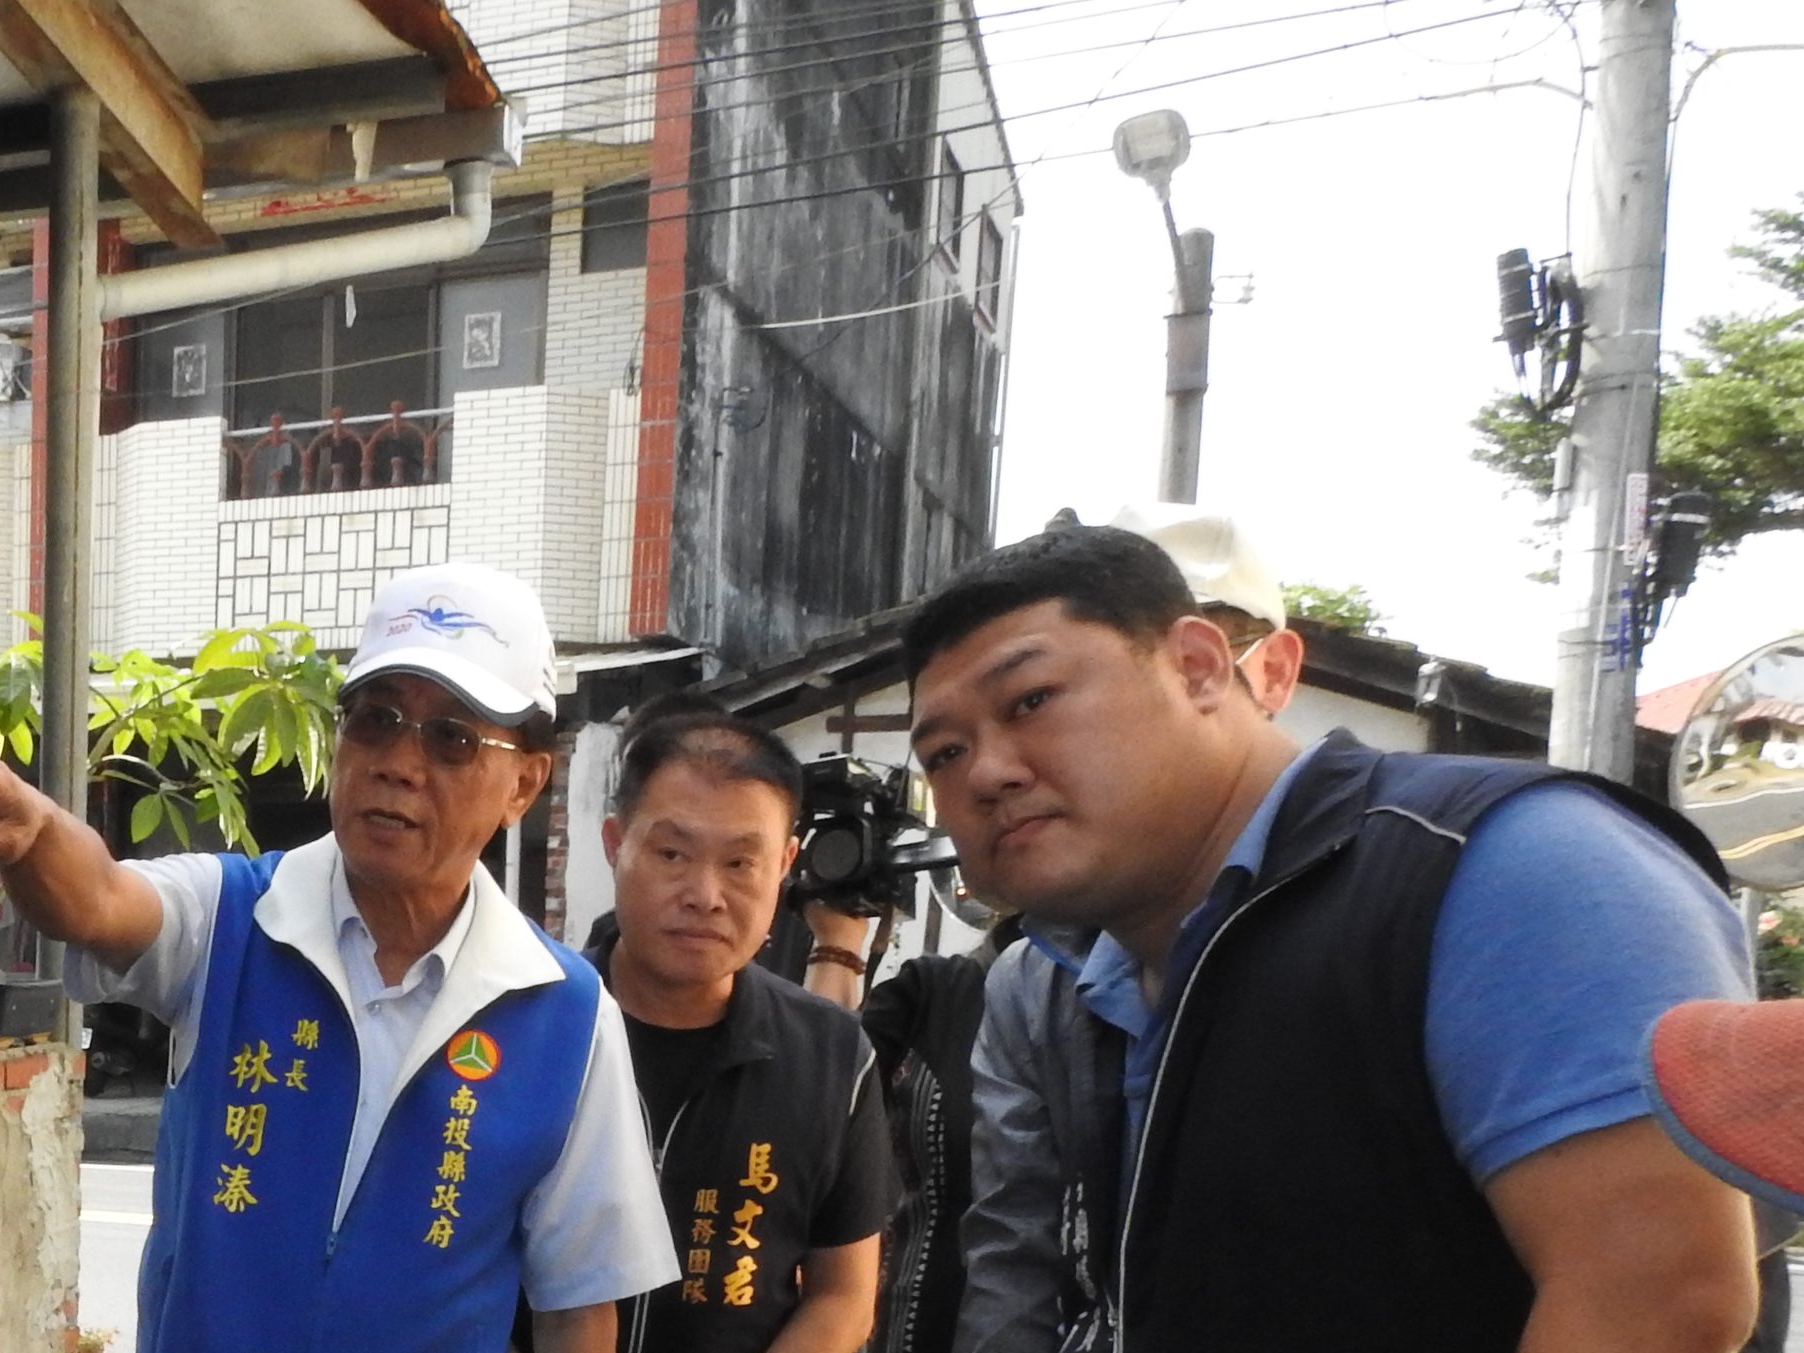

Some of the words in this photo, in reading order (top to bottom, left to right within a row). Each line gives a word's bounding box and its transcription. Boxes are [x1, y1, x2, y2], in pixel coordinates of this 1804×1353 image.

[284, 1019, 319, 1091] 縣長
[213, 1040, 278, 1212] 林明溱
[423, 1084, 478, 1248] 南投縣政府
[682, 1188, 720, 1304] 服務團隊
